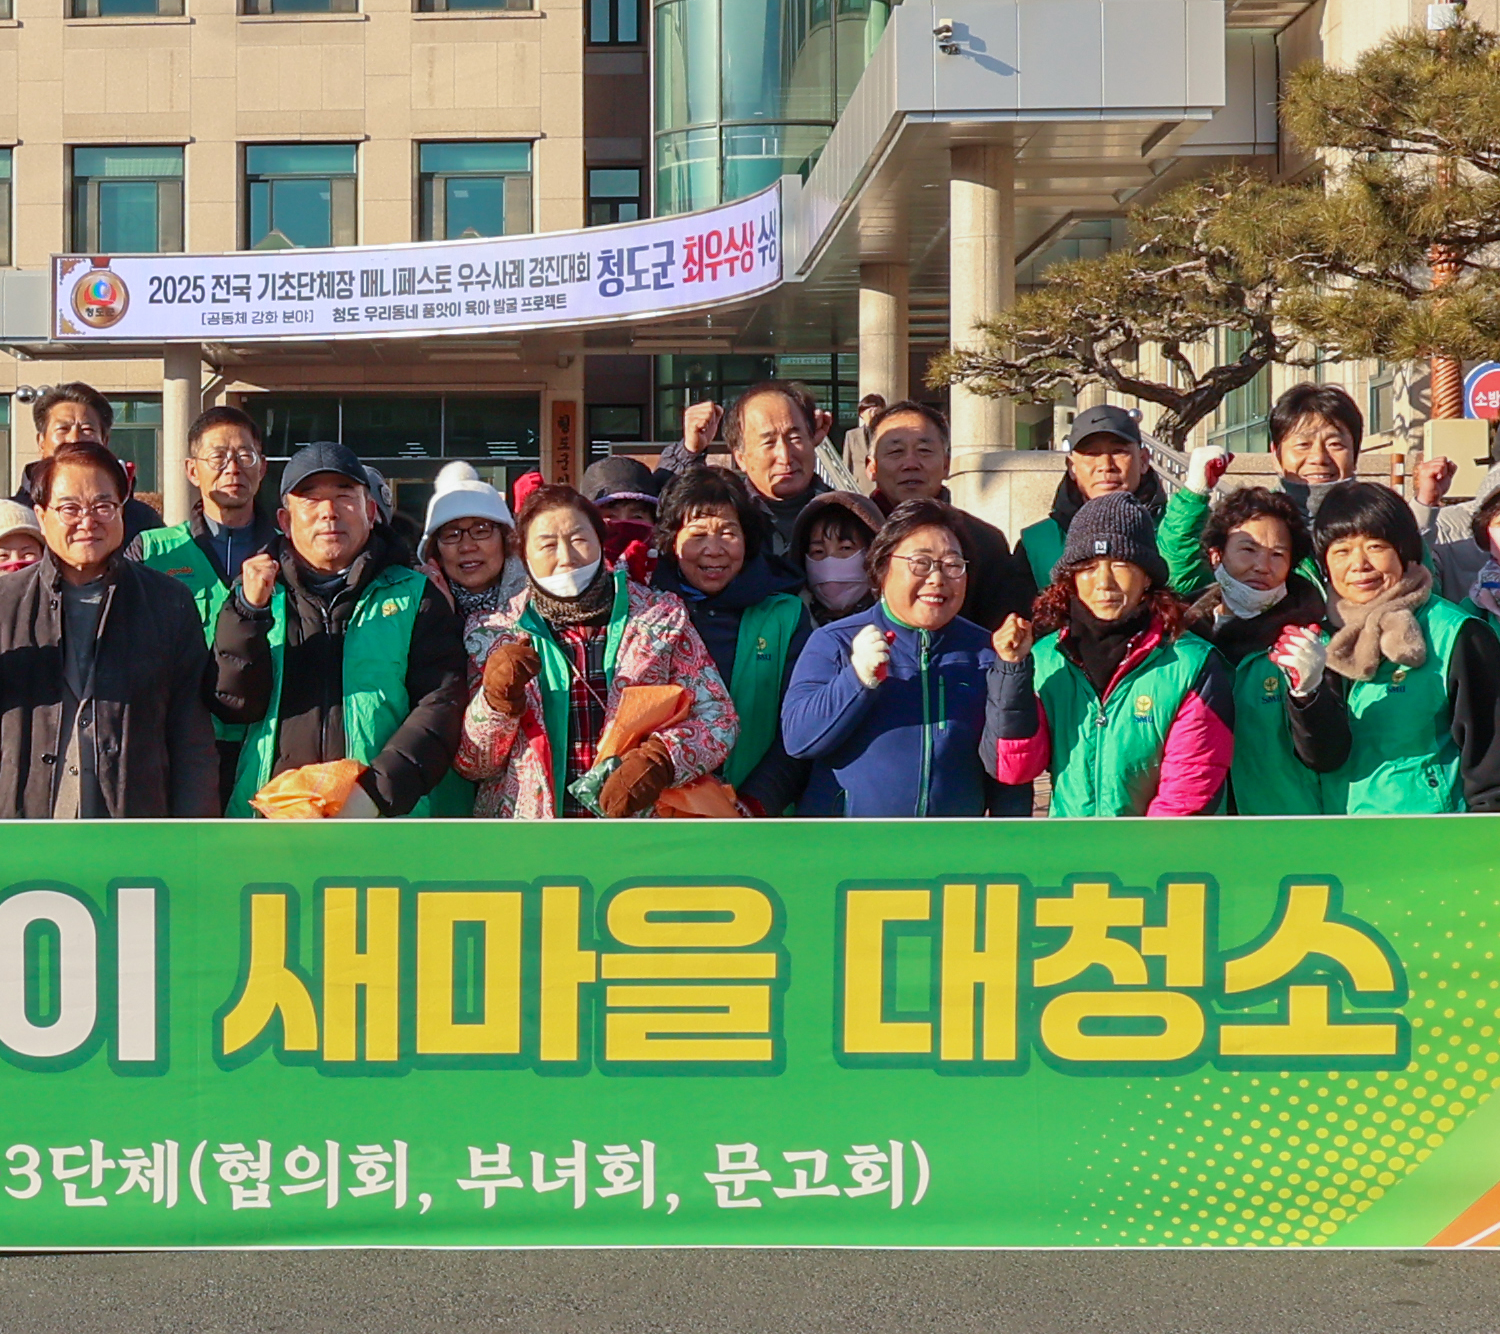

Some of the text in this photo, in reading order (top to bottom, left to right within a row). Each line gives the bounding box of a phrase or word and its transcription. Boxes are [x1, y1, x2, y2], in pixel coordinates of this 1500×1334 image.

[148, 274, 206, 304] 2025
[210, 273, 252, 304] 전국
[256, 269, 355, 303] 기초단체장
[360, 264, 452, 299] 매니페스토
[457, 258, 525, 294] 우수사례
[528, 251, 591, 289] 경진대회
[597, 240, 676, 299] 청도군
[681, 220, 755, 284] 최우수상
[201, 292, 568, 327] [공동체 강화 분야] 청도 우리동네 품앗이 육아 발굴 프로젝트
[221, 884, 778, 1062] 새마을
[844, 883, 1399, 1062] 대청소
[456, 1139, 680, 1215] 부녀회,
[702, 1139, 932, 1211] 문고회)
